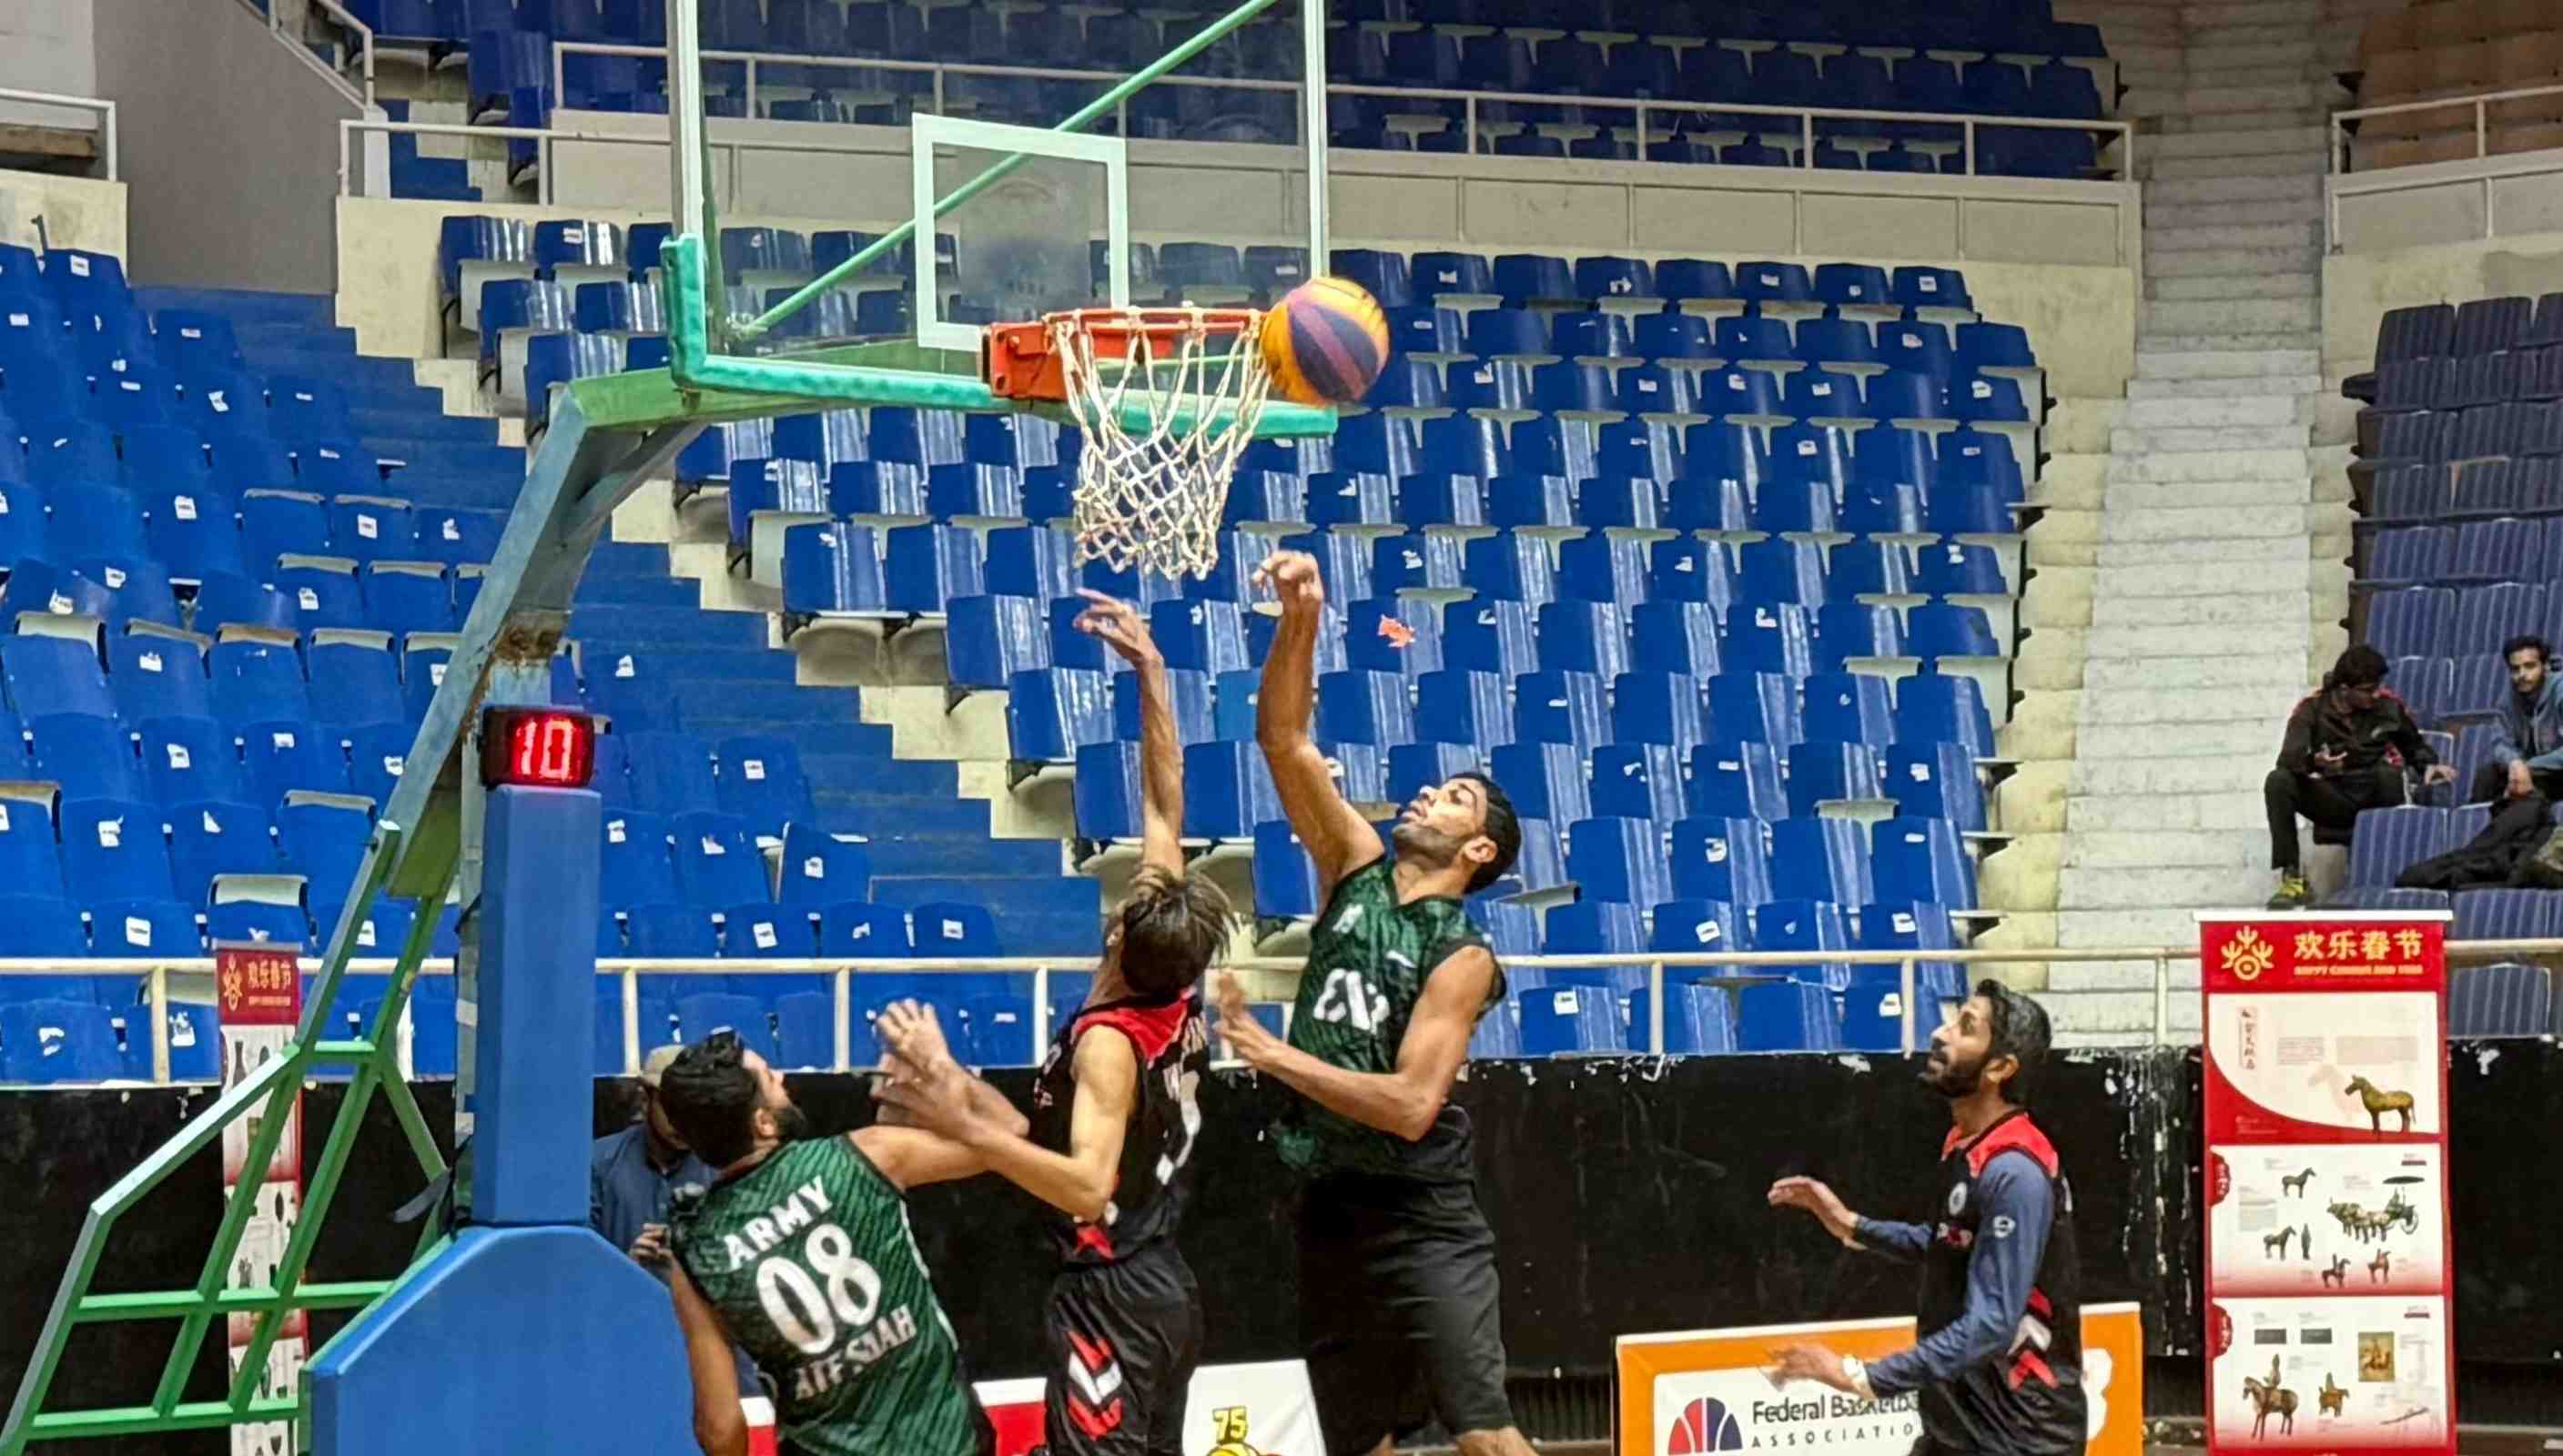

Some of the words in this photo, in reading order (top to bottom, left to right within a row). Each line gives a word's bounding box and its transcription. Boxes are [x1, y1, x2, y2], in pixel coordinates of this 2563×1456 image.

[520, 718, 573, 780] 10
[2293, 930, 2424, 960] 欢乐春节
[724, 1175, 833, 1271] ARMY
[756, 1223, 881, 1354] 08
[1212, 1405, 1248, 1445] 75
[1752, 1393, 1825, 1424] Federal
[1752, 1422, 1913, 1448] ASSOCIATIO
